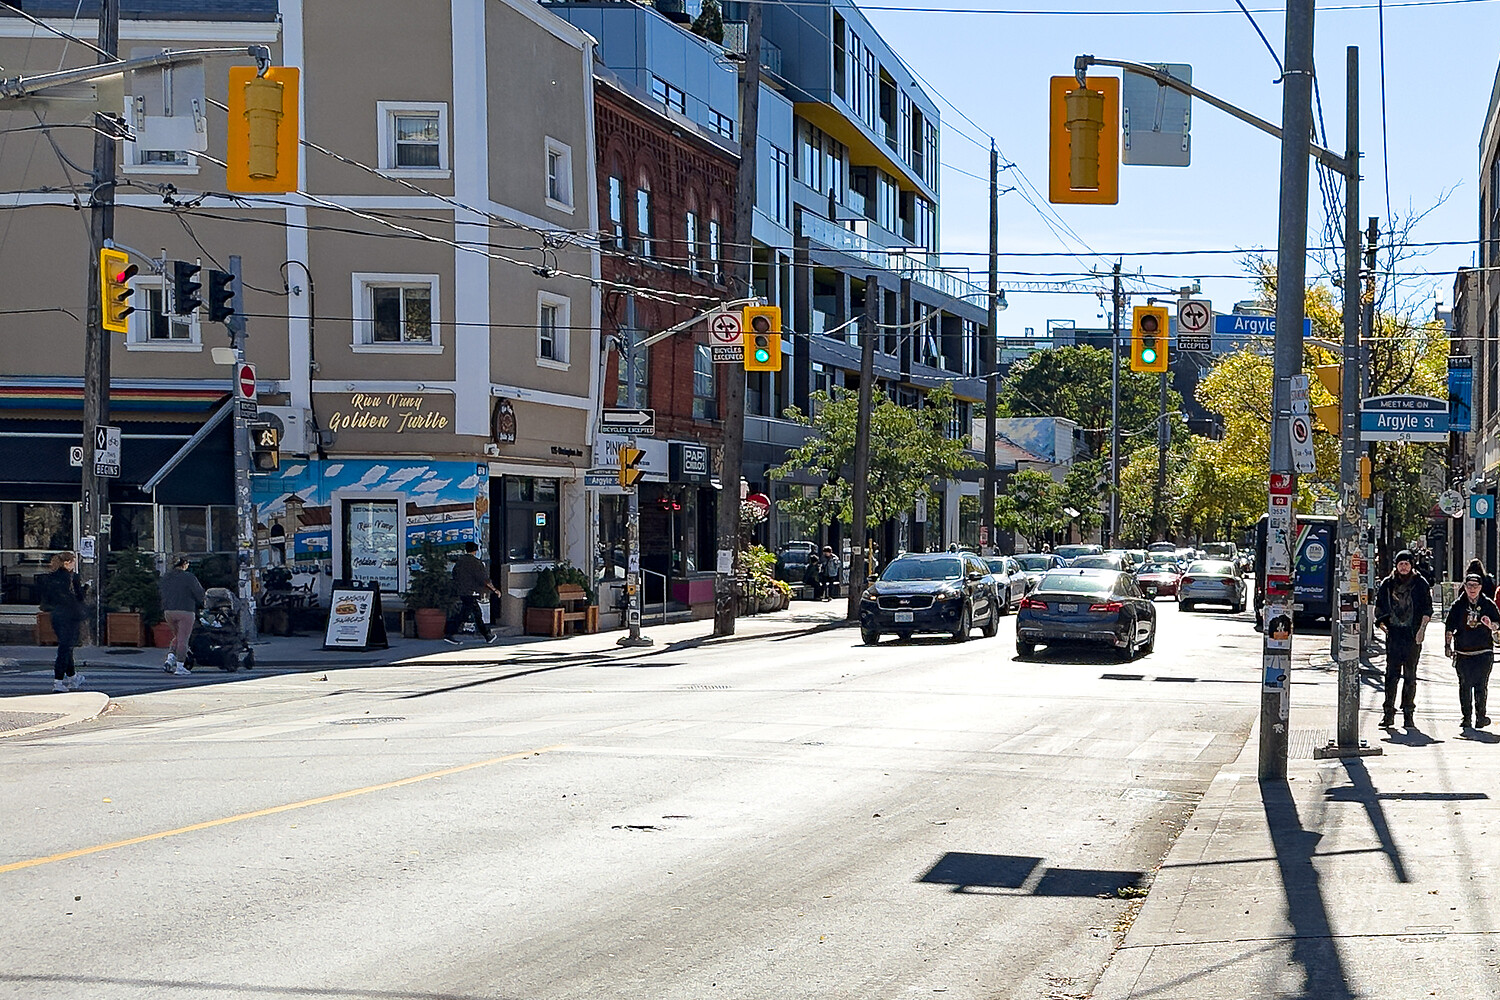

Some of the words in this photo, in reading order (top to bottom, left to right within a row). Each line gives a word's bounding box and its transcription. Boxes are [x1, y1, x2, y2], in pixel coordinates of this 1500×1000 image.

[1234, 316, 1276, 333] Argyle
[329, 411, 390, 433] Golden
[397, 411, 449, 433] Turtle
[1377, 413, 1418, 430] Argyle
[1424, 417, 1434, 428] St
[685, 449, 705, 460] PAPI
[96, 464, 119, 476] BEGINS
[591, 476, 612, 485] Argyle
[333, 615, 366, 625] SNACKS
